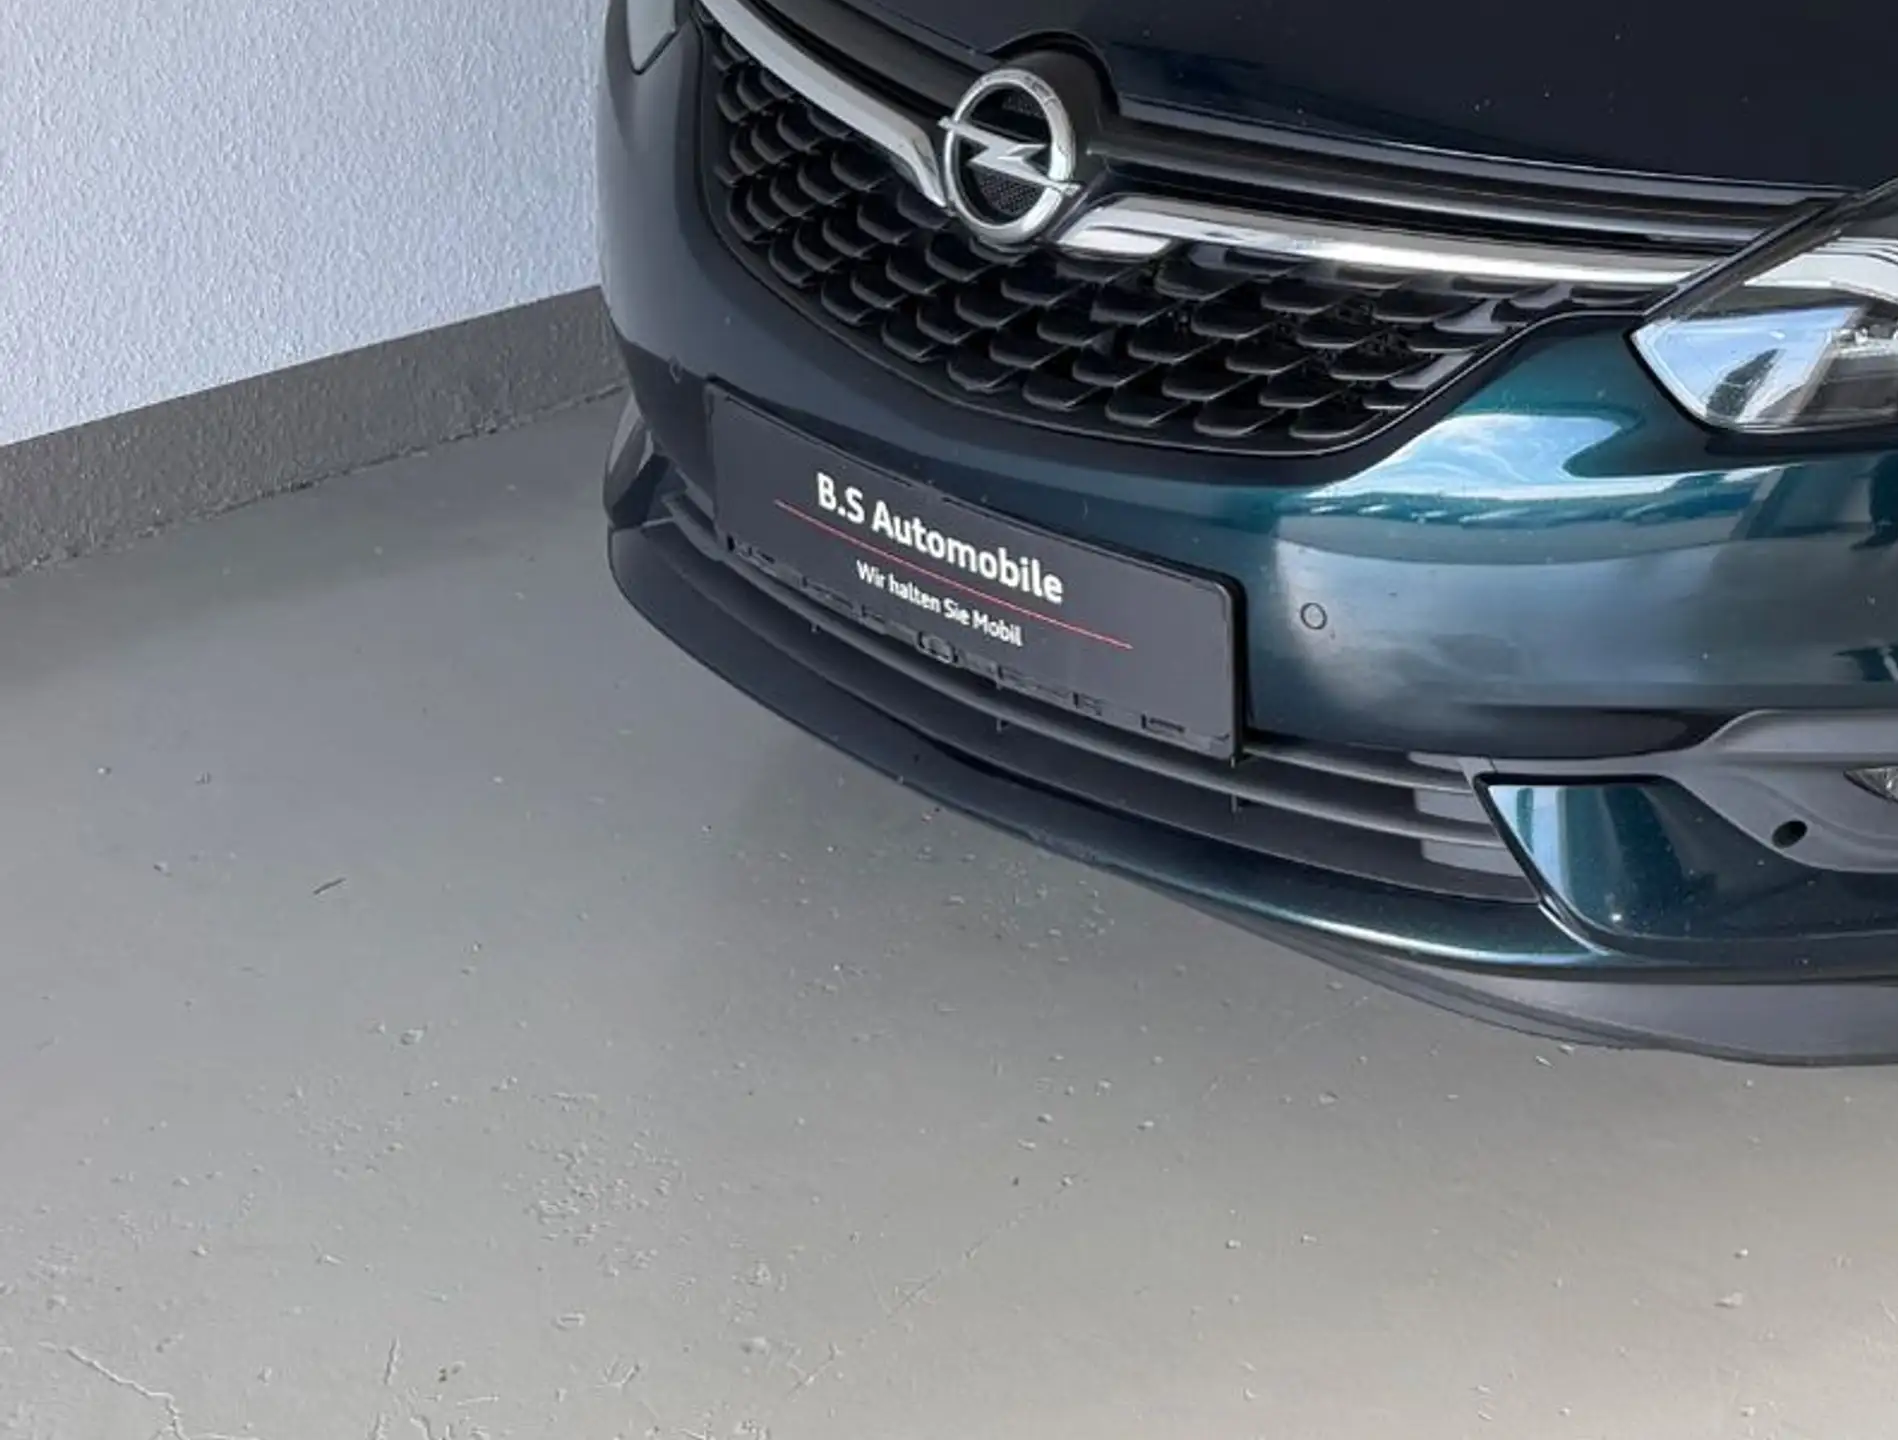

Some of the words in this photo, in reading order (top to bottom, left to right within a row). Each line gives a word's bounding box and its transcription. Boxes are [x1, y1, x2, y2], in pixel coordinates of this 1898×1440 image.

[817, 472, 866, 524] B.S
[871, 499, 1063, 604] Automobile
[856, 559, 886, 589] Wir
[888, 572, 941, 613] halten
[943, 597, 970, 626] Sie
[971, 609, 1023, 647] Mobil
